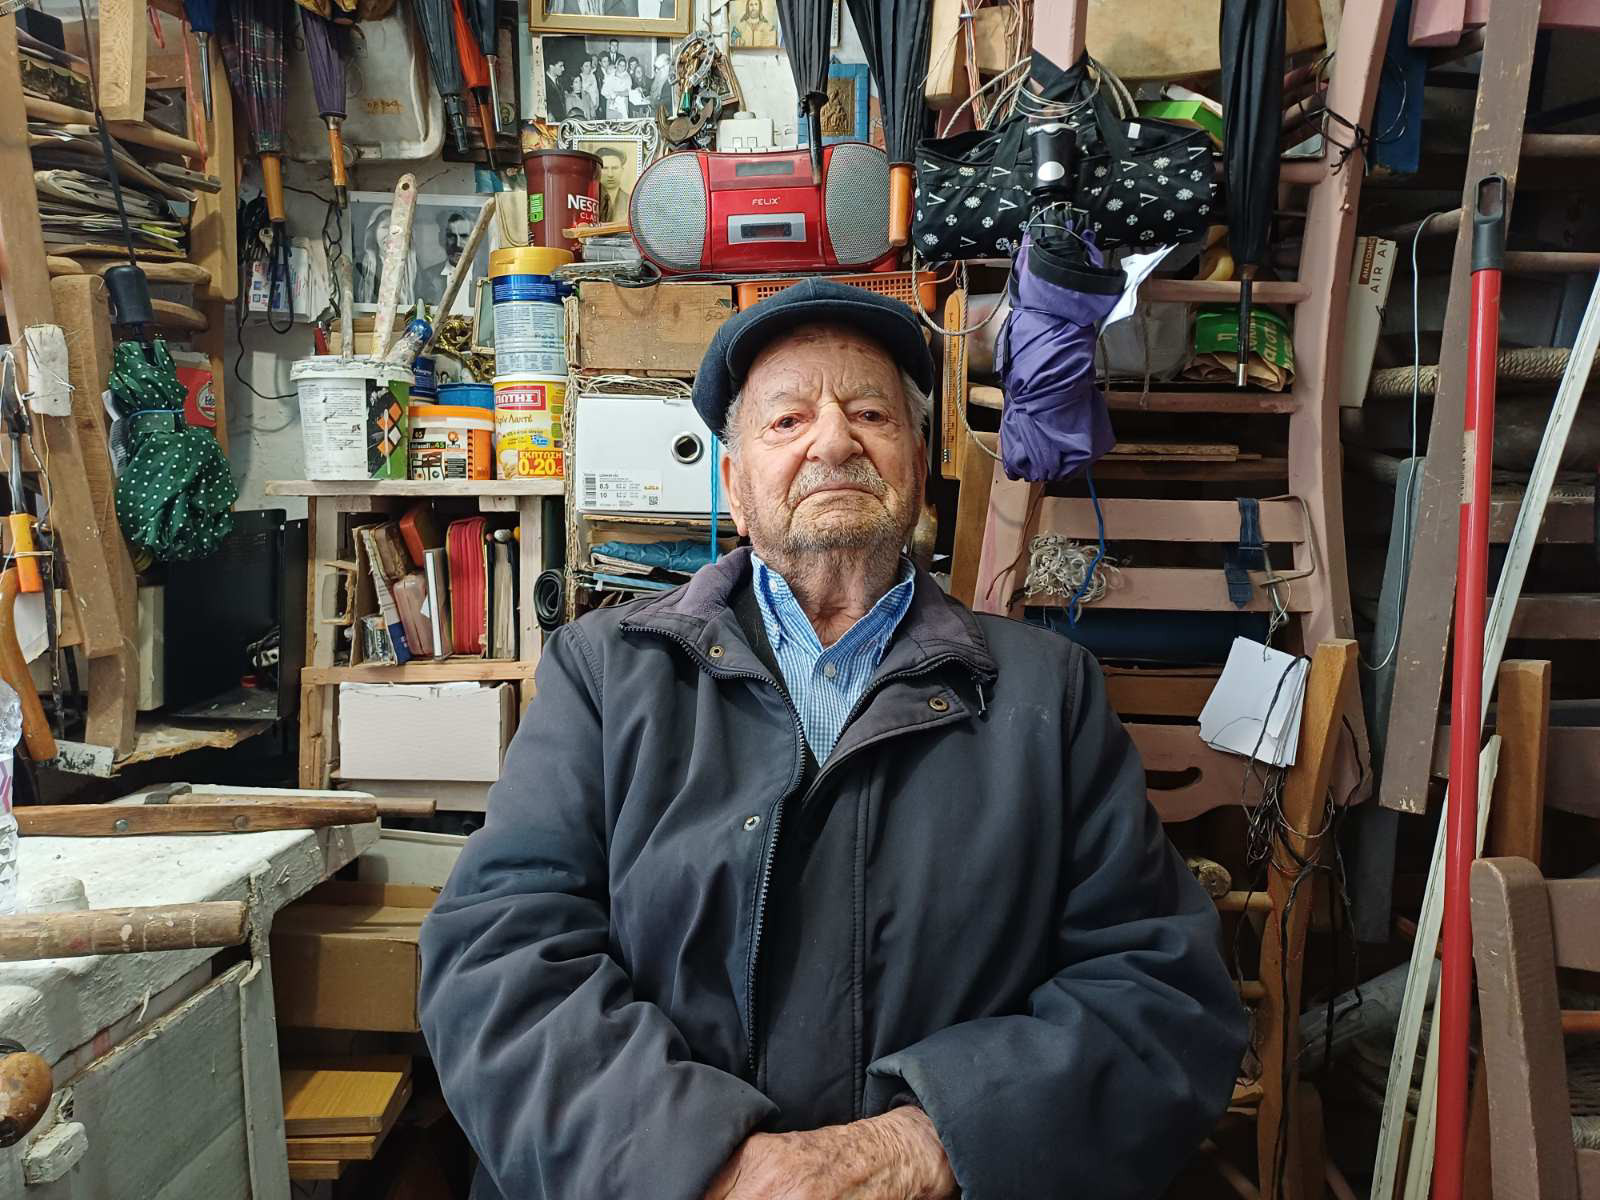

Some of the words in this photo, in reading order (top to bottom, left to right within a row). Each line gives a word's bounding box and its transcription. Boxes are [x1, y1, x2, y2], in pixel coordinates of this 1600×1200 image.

[567, 193, 599, 213] NESC
[752, 197, 778, 206] FELIX
[1370, 267, 1383, 293] AIR
[519, 451, 562, 459] ΕΚΠΤΩΣΗ
